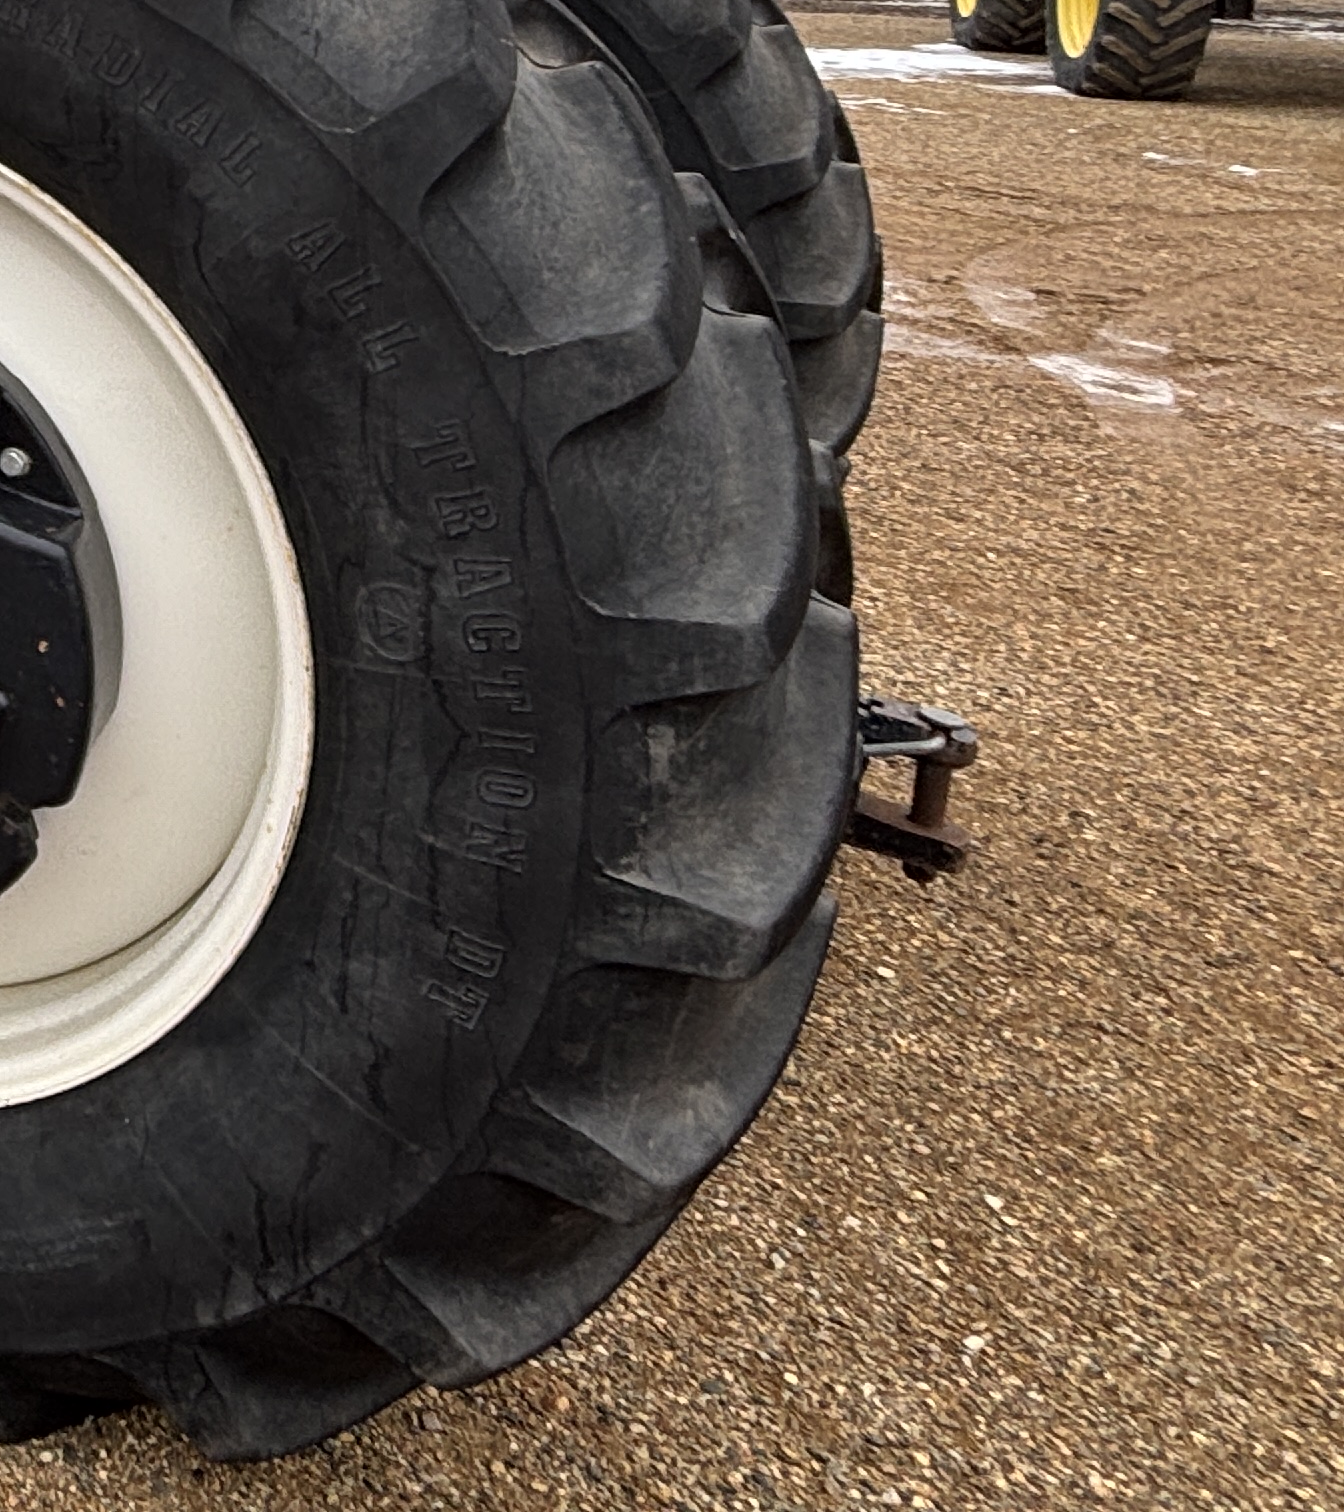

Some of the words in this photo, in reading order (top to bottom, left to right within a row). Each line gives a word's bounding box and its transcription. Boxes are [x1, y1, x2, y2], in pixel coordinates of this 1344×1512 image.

[288, 215, 422, 375] ALL
[410, 417, 539, 876] TRACTION
[424, 925, 510, 1033] DT
